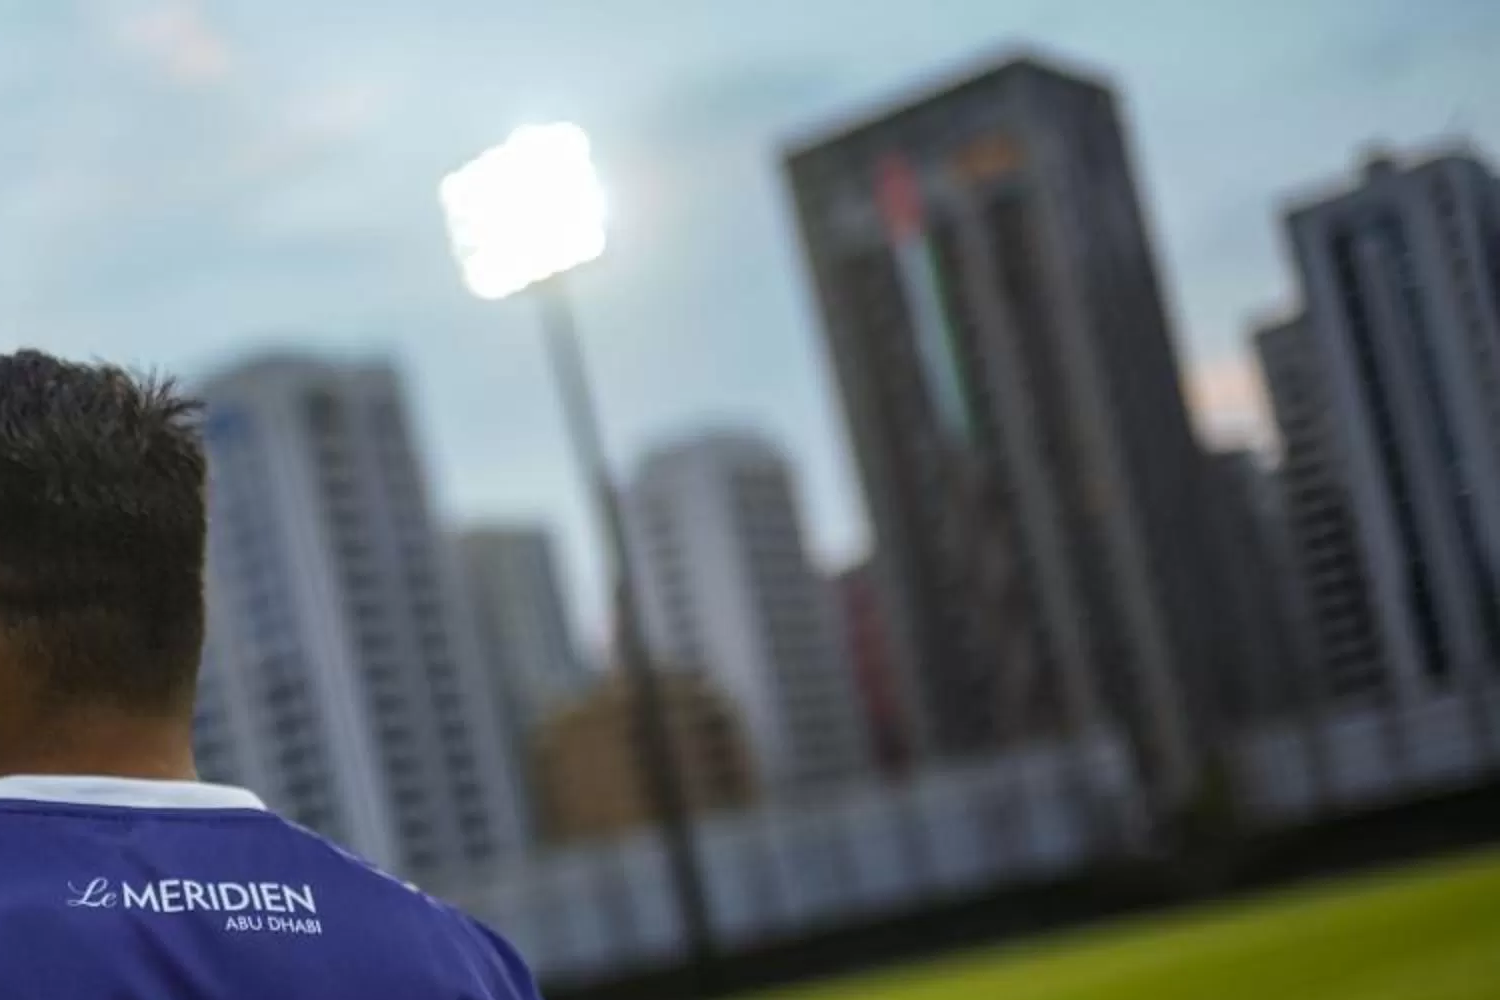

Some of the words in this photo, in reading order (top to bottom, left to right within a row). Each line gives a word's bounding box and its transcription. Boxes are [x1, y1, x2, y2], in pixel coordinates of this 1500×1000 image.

[67, 876, 117, 908] Le
[121, 879, 317, 913] MERIDIEN
[225, 916, 263, 931] ABU
[268, 917, 322, 934] DHABI
